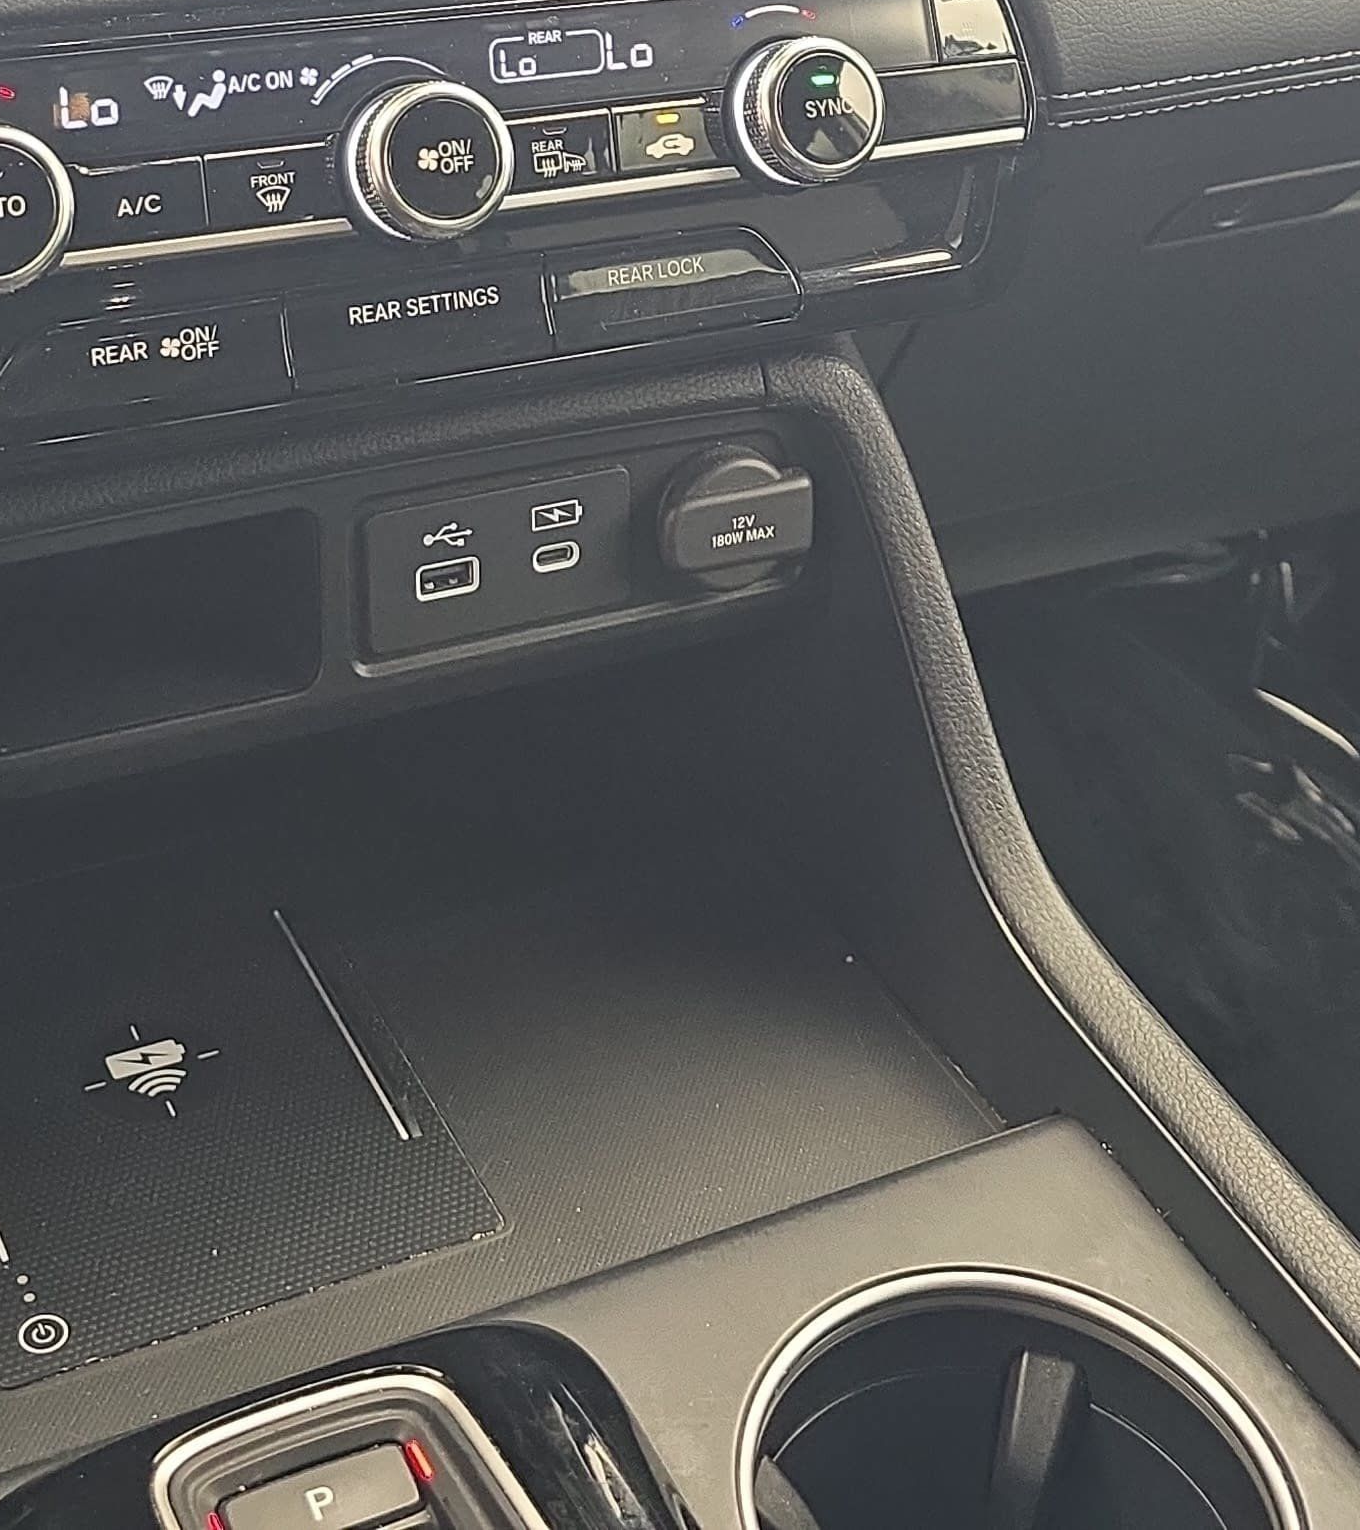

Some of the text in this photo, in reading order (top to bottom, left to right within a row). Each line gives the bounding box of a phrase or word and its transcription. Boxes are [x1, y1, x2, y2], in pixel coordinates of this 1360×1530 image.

[528, 30, 562, 45] REAR
[228, 70, 293, 94] A/C ON
[805, 98, 853, 119] SYNC
[438, 139, 472, 158] ON/
[531, 139, 563, 153] REAR
[441, 156, 475, 174] OFF
[250, 171, 296, 188] FRONT
[117, 194, 161, 217] A/C
[607, 256, 705, 287] REAR LOCK
[348, 286, 500, 325] REAR SETTINGS
[180, 324, 218, 343] ON/
[90, 341, 148, 367] REAR
[181, 341, 220, 361] OFF
[731, 514, 755, 529] 12V
[711, 525, 775, 548] 180W MAX
[305, 1486, 334, 1521] P
